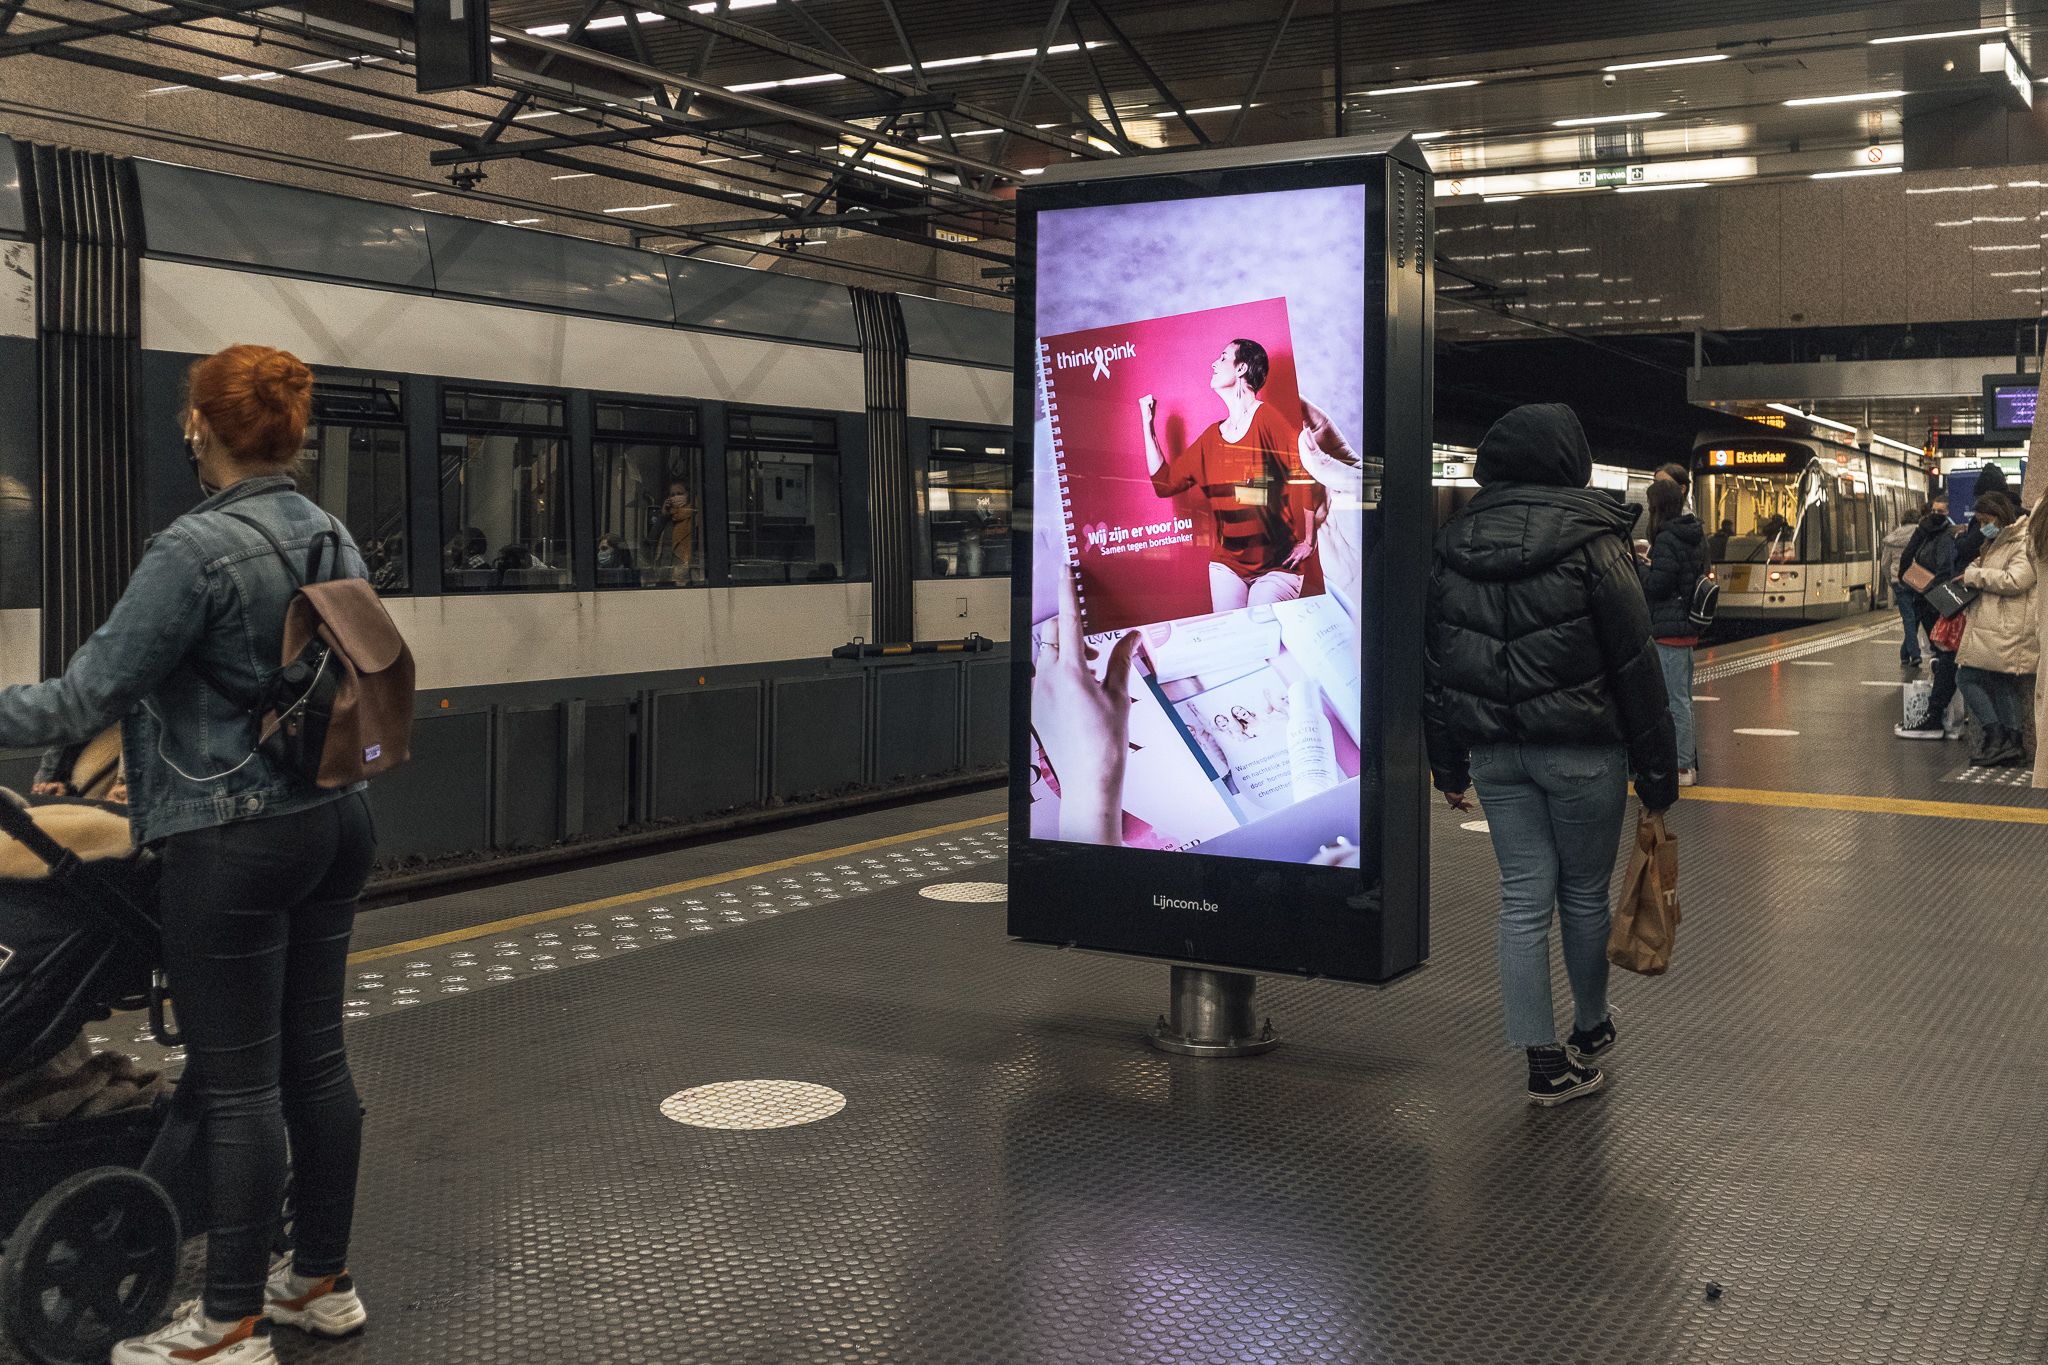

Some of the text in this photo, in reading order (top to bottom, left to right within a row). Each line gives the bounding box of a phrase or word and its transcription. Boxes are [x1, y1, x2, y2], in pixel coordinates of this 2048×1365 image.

[1596, 172, 1626, 181] UITGANG
[1056, 341, 1137, 369] think pink
[1716, 450, 1786, 466] 9 Eksterlaar
[1088, 517, 1193, 545] Wij zijn er voor jou
[1101, 534, 1193, 556] Samen tegen borstkanker
[1250, 780, 1264, 789] door
[1153, 894, 1219, 912] Lijncom.be
